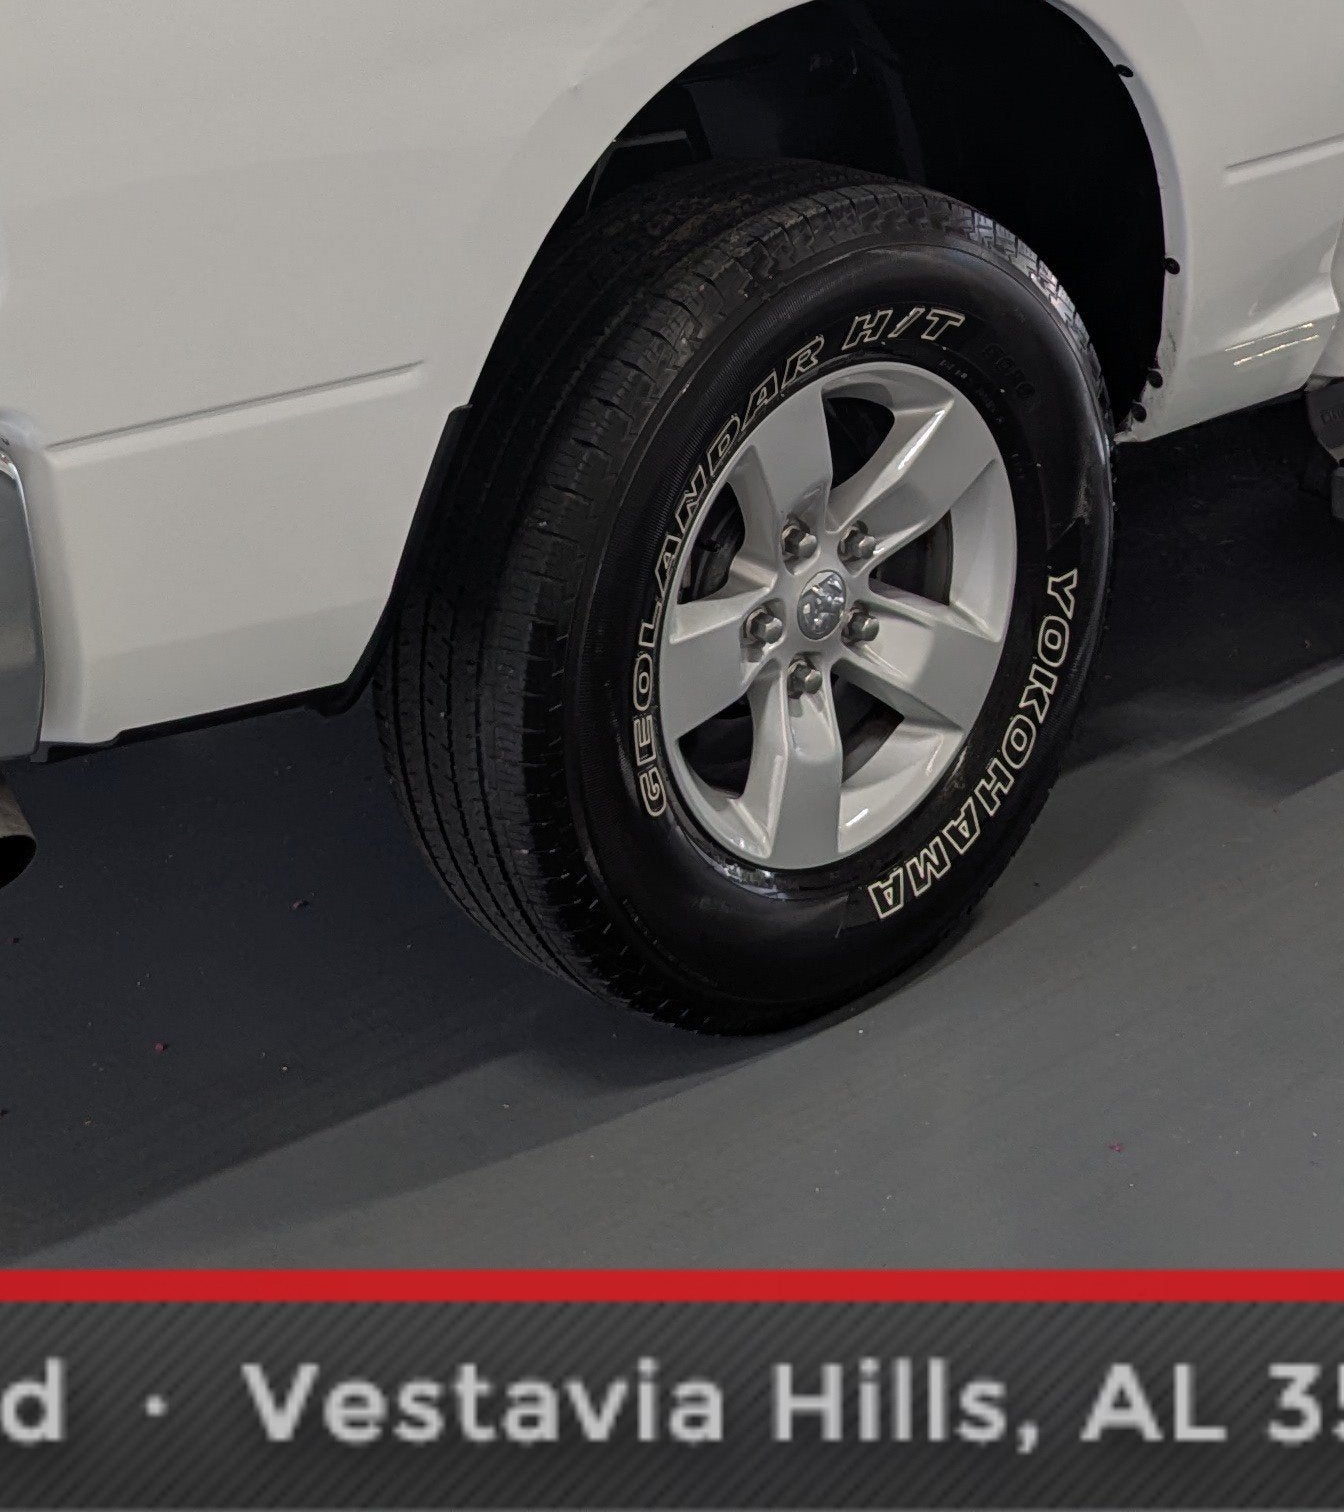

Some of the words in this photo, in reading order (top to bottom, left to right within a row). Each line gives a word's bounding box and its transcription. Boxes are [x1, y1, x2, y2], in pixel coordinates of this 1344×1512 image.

[632, 334, 826, 817] GEOLANDAR
[841, 307, 966, 352] H/T
[867, 567, 1080, 920] YOKOHAMA
